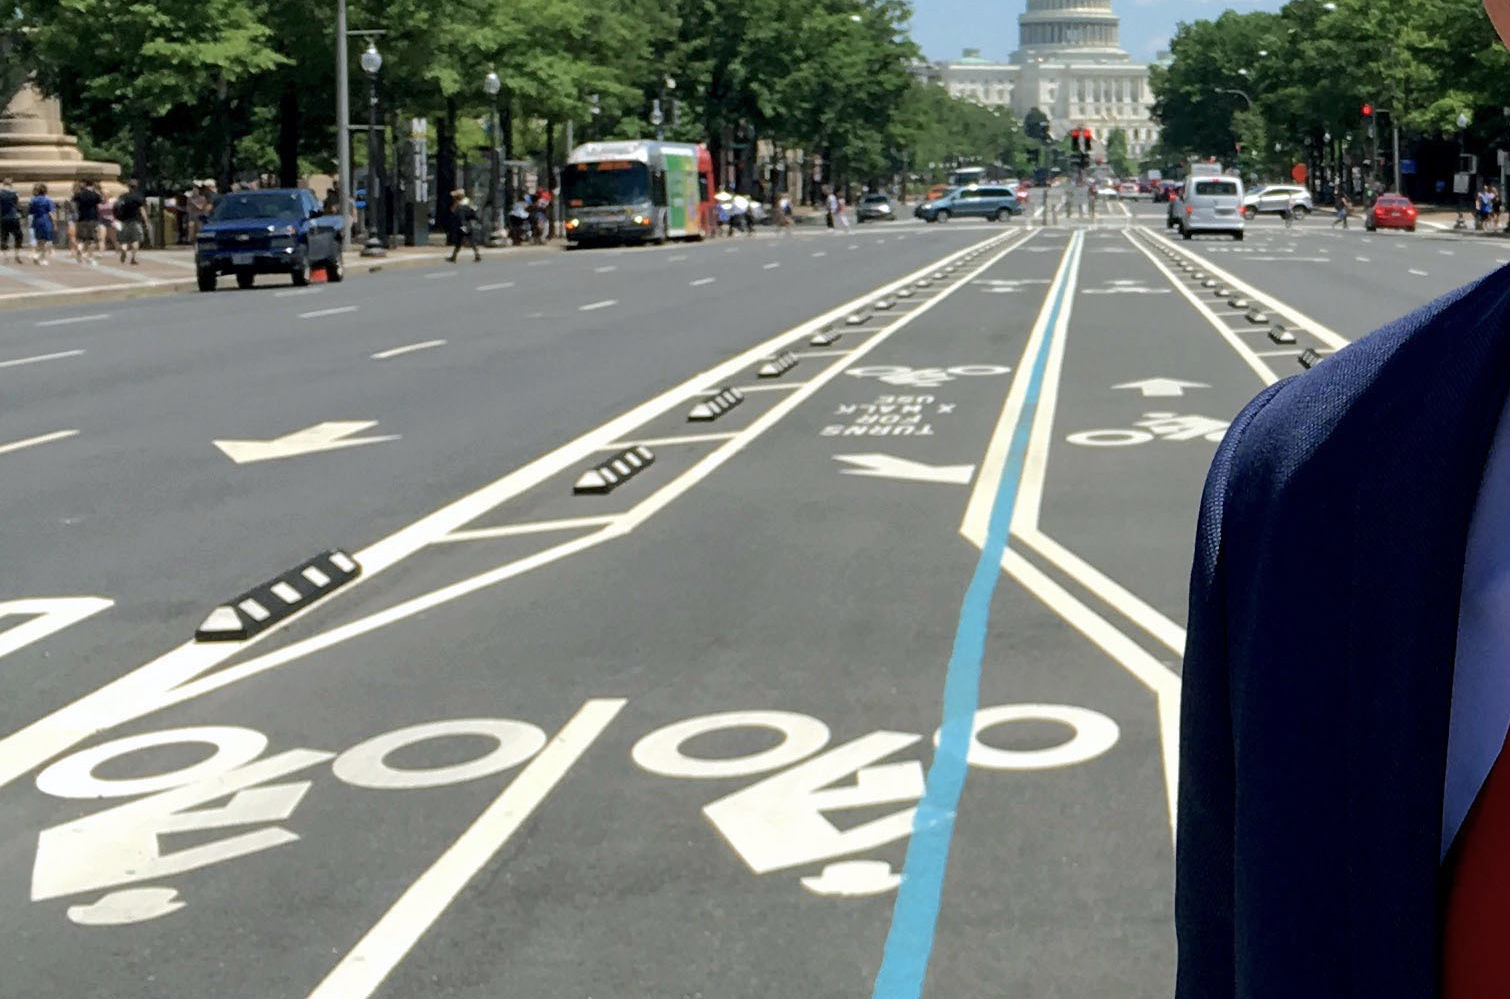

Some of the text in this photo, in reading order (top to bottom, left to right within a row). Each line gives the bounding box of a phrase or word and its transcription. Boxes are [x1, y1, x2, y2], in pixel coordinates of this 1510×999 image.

[876, 394, 935, 404] USE
[834, 403, 957, 415] X WALK
[855, 414, 922, 424] FOR
[819, 423, 935, 436] TURNS
